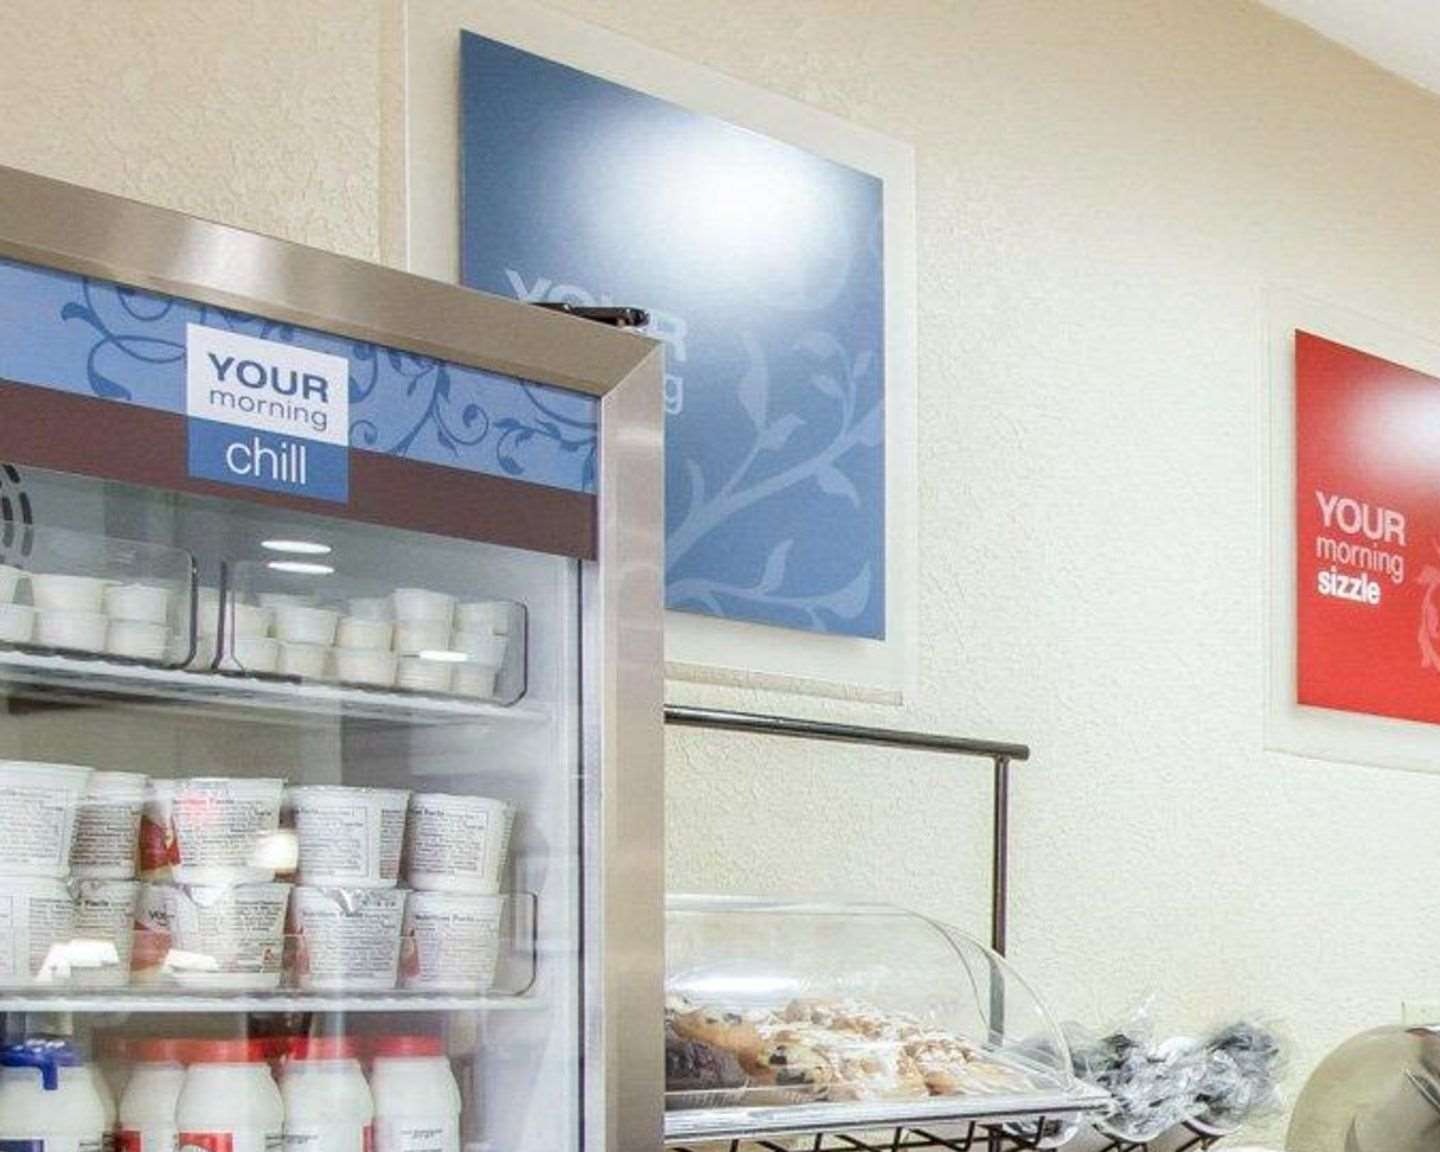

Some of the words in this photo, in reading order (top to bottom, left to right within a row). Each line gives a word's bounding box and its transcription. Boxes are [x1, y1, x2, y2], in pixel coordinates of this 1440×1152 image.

[208, 352, 329, 403] YOUR
[209, 389, 328, 432] morning
[226, 437, 307, 485] chill
[1315, 491, 1406, 546] YOUR
[1316, 536, 1404, 584] morning
[1318, 567, 1381, 605] sizzle
